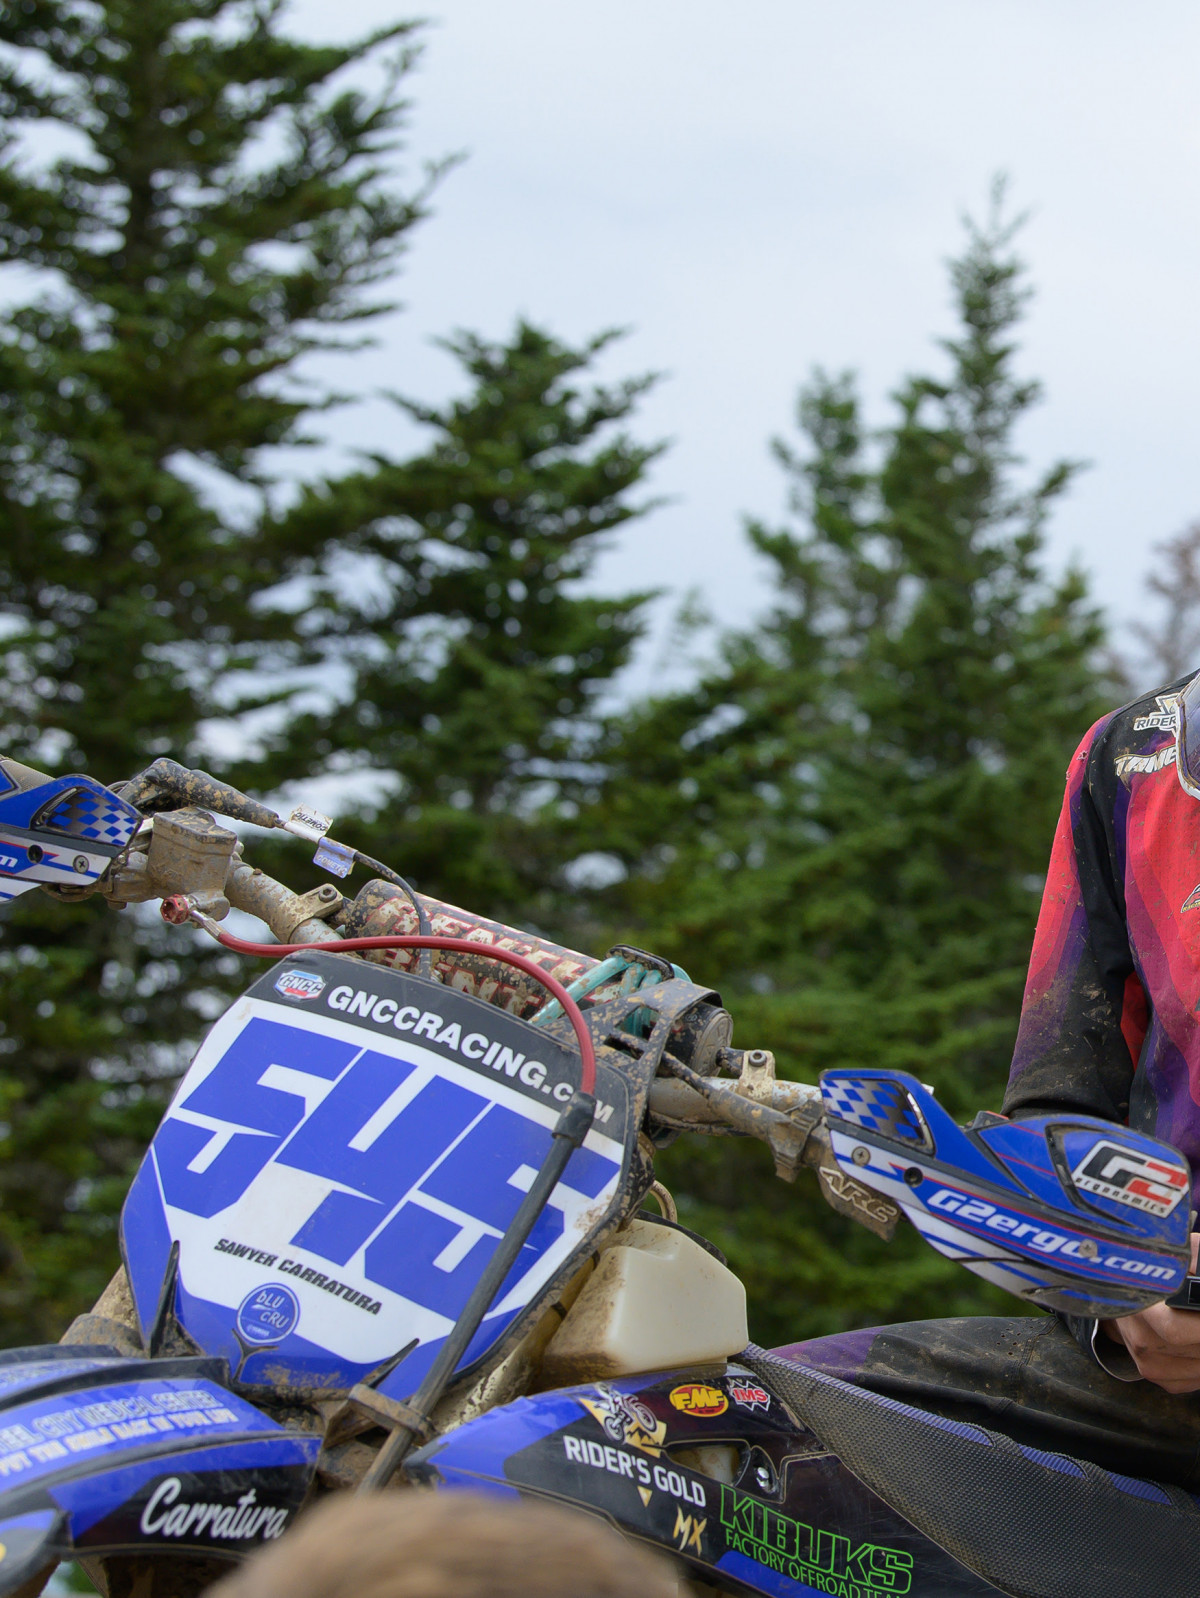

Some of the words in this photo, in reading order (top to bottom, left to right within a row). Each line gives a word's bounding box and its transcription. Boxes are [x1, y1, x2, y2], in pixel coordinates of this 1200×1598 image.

[277, 972, 323, 996] GNCC
[327, 985, 612, 1123] GNCCRACING.CM
[819, 1166, 897, 1222] ARC
[1074, 1177, 1168, 1216] ergonomics
[214, 1238, 276, 1270] SAWYER
[278, 1260, 383, 1316] CARRATURA
[673, 1387, 725, 1411] FMF
[733, 1388, 769, 1403] IMS
[32, 1409, 85, 1439] CITY
[563, 1434, 652, 1486] RIDER'S
[653, 1465, 707, 1508] GOLD
[140, 1476, 290, 1539] Carratura
[673, 1503, 708, 1556] MX
[719, 1484, 914, 1595] KIBUKS
[725, 1527, 787, 1574] FACTORY
[788, 1561, 861, 1598] OFFROAD
